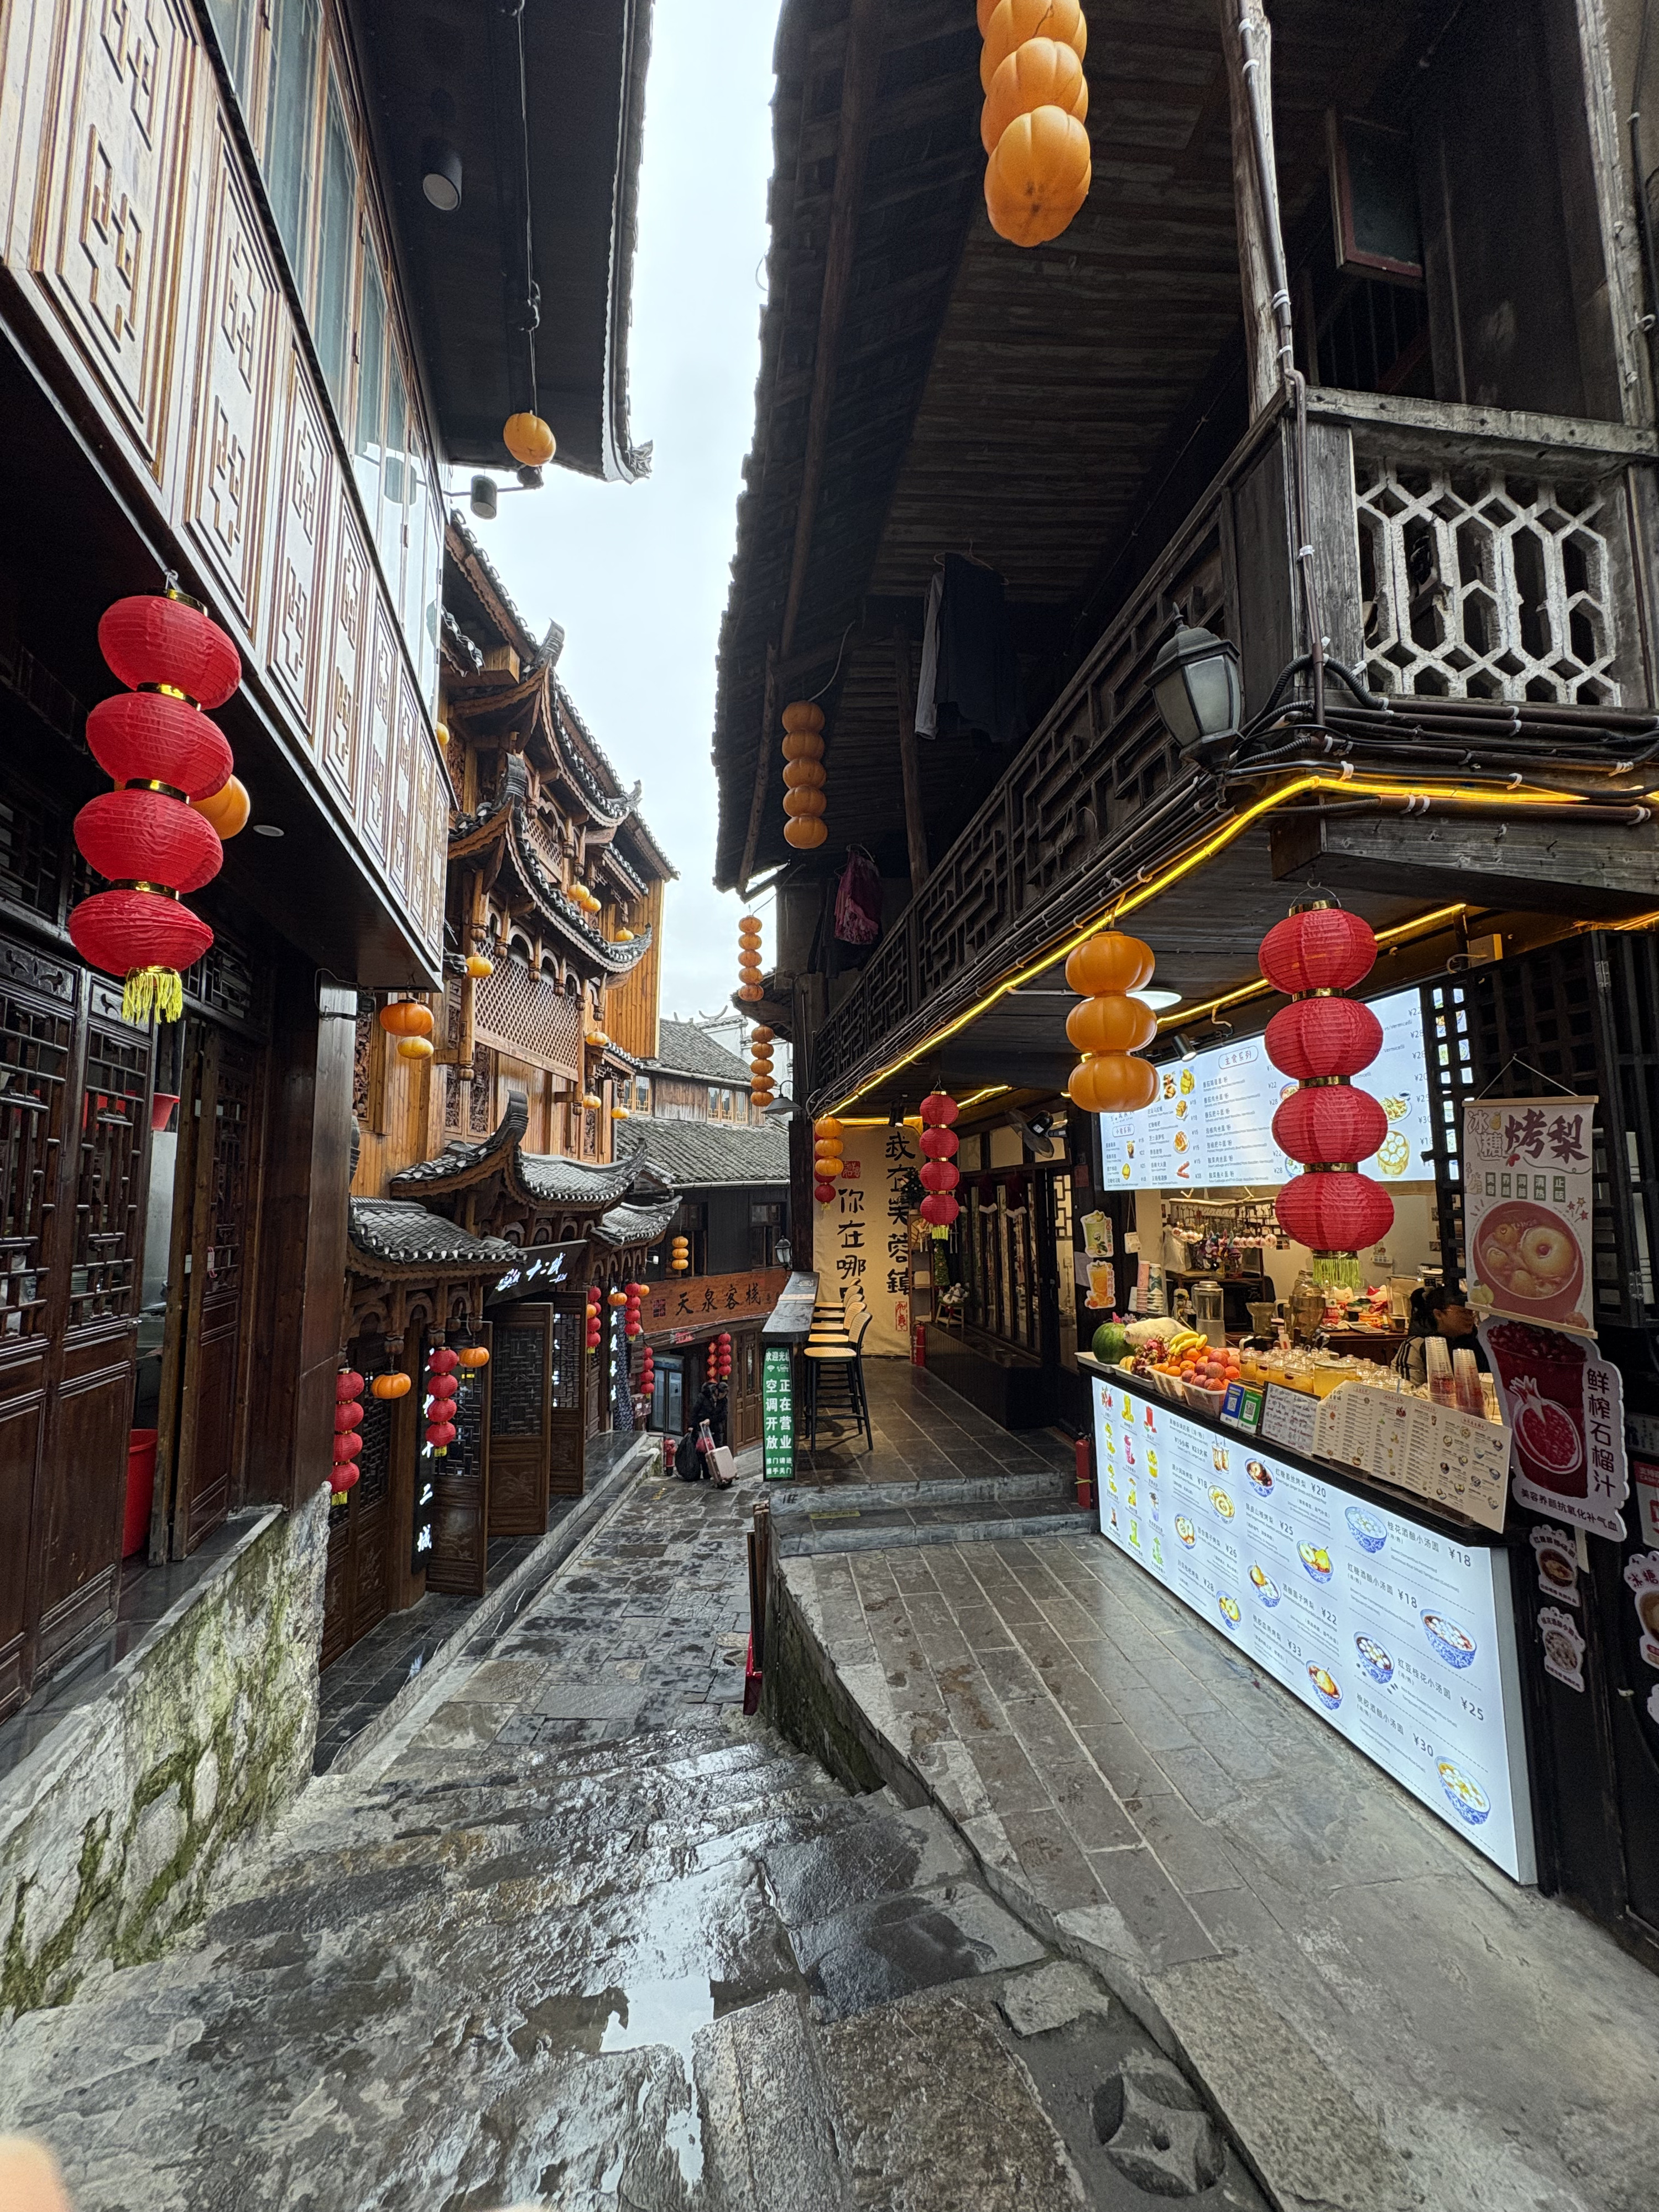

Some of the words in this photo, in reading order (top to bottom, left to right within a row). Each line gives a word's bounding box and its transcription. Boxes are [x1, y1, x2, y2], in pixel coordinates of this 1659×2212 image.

[1224, 1049, 1251, 1065] 主食系列
[1467, 1109, 1503, 1157] 冰糖
[1505, 1108, 1589, 1164] 烤梨
[1535, 1177, 1545, 1199] 清热
[1554, 1178, 1564, 1200] 止咳
[837, 1188, 866, 1301] 你在哪
[765, 1379, 778, 1449] 空调开放
[779, 1379, 792, 1449] 正在营业
[1587, 1368, 1616, 1498] 鲜榨石榴汁
[1197, 1476, 1207, 1489] ¥18
[1311, 1482, 1326, 1498] ¥20
[1521, 1488, 1618, 1532] 美容养颜抗氧化补气血
[1280, 1520, 1293, 1536] ¥25
[1225, 1543, 1237, 1558] ¥26
[1387, 1520, 1439, 1553] 桂花酒酿小汤圆
[1448, 1546, 1471, 1567] ¥18
[1203, 1577, 1213, 1592] ¥28
[1397, 1588, 1417, 1609] ¥18
[1321, 1606, 1337, 1626] ¥22
[1287, 1638, 1301, 1657] ¥33
[1397, 1656, 1451, 1700] 红豆桂花小汤圆
[1460, 1695, 1484, 1722] ¥25
[1413, 1732, 1433, 1758] ¥30
